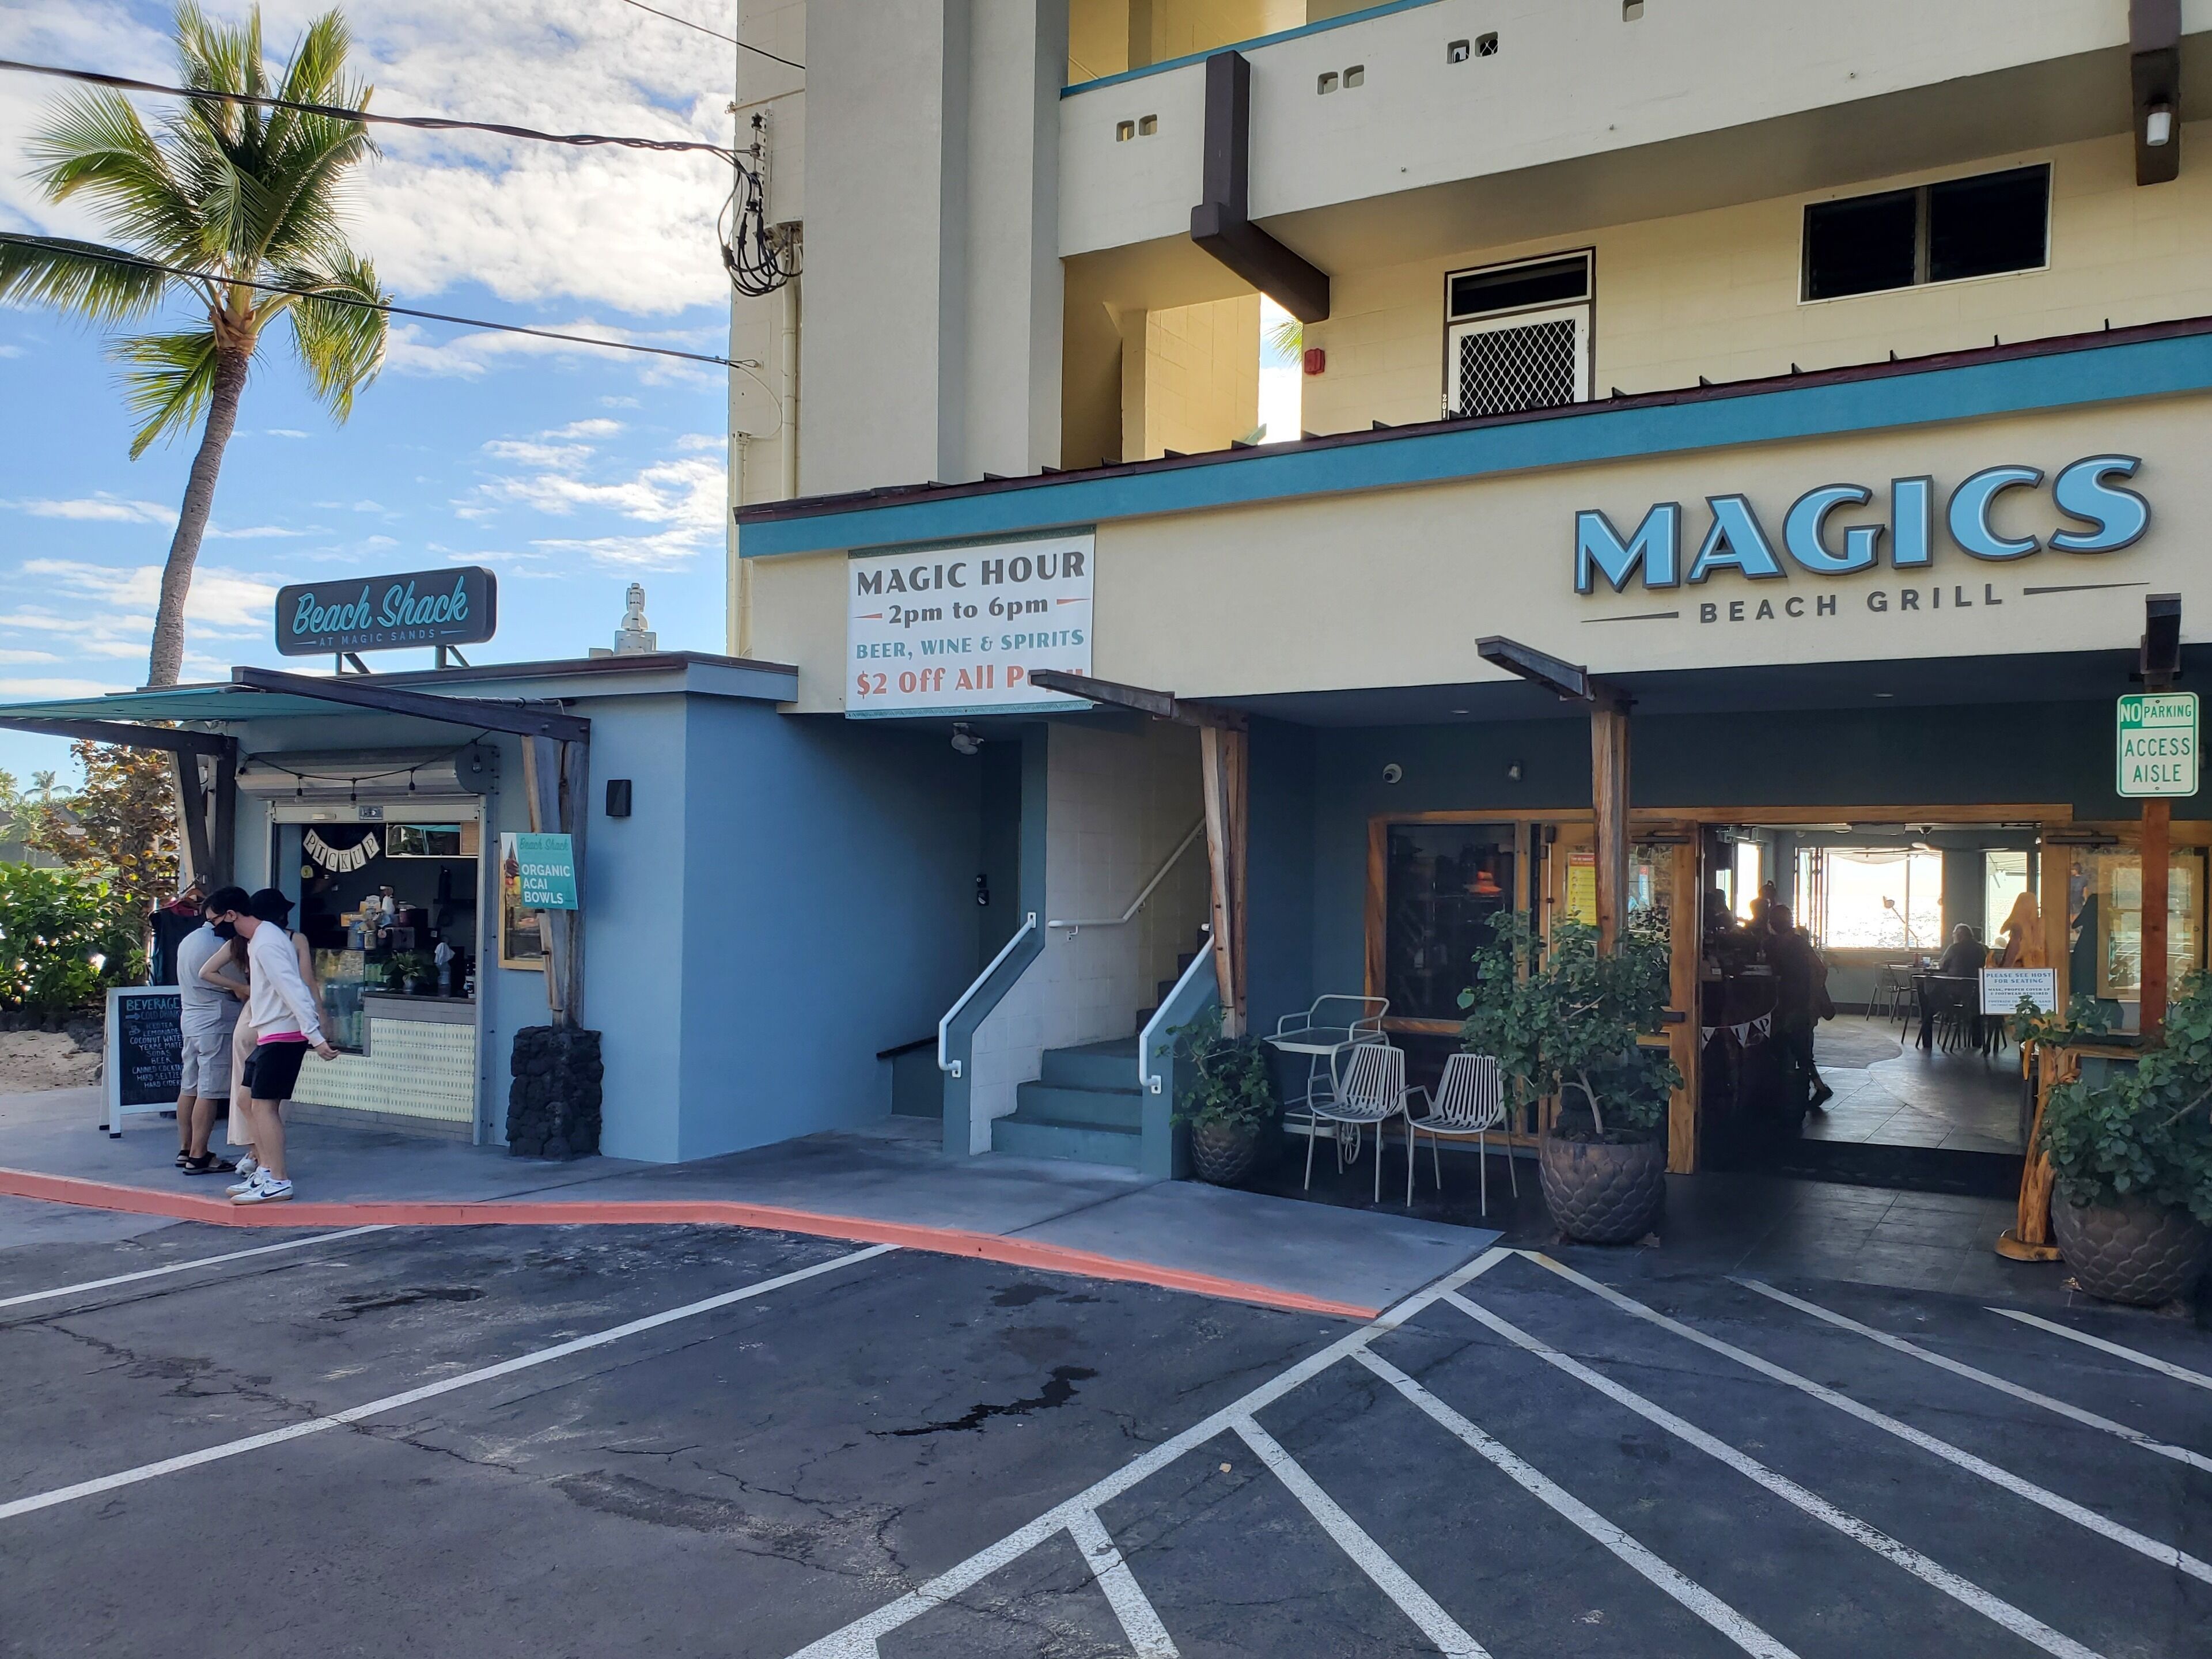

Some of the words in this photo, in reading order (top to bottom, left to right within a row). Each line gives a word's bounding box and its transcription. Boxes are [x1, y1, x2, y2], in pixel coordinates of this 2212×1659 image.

[1574, 454, 2152, 595] MAGICS
[858, 562, 967, 596] MAGIC
[982, 551, 1085, 585] HOUR
[293, 585, 373, 635] Beach
[377, 575, 468, 628] Shack
[889, 604, 942, 628] 2pm
[953, 602, 978, 619] to
[988, 597, 1048, 621] 6pm
[1700, 594, 1837, 624] BEACH
[1867, 584, 2002, 612] GRILL
[319, 637, 334, 646] AT
[342, 632, 382, 645] MAGIC
[391, 629, 435, 641] SANDS
[857, 642, 913, 660] BEER,
[921, 638, 972, 656] WINE
[980, 636, 993, 652] &
[1001, 629, 1084, 650] SPIRITS
[857, 671, 887, 699] $2
[899, 666, 946, 693] Off
[956, 665, 994, 691] All
[2120, 703, 2142, 722] NO
[2144, 704, 2191, 718] PARKING
[2124, 737, 2190, 757] ACCESS
[2133, 764, 2181, 783] AISLE
[521, 863, 571, 877] ORGANIC
[523, 877, 547, 890] ACAI
[524, 891, 563, 904] BOWLS
[160, 1009, 181, 1019] DRINK
[130, 1036, 161, 1044] COCONUT
[143, 1028, 180, 1037] LEMONADE
